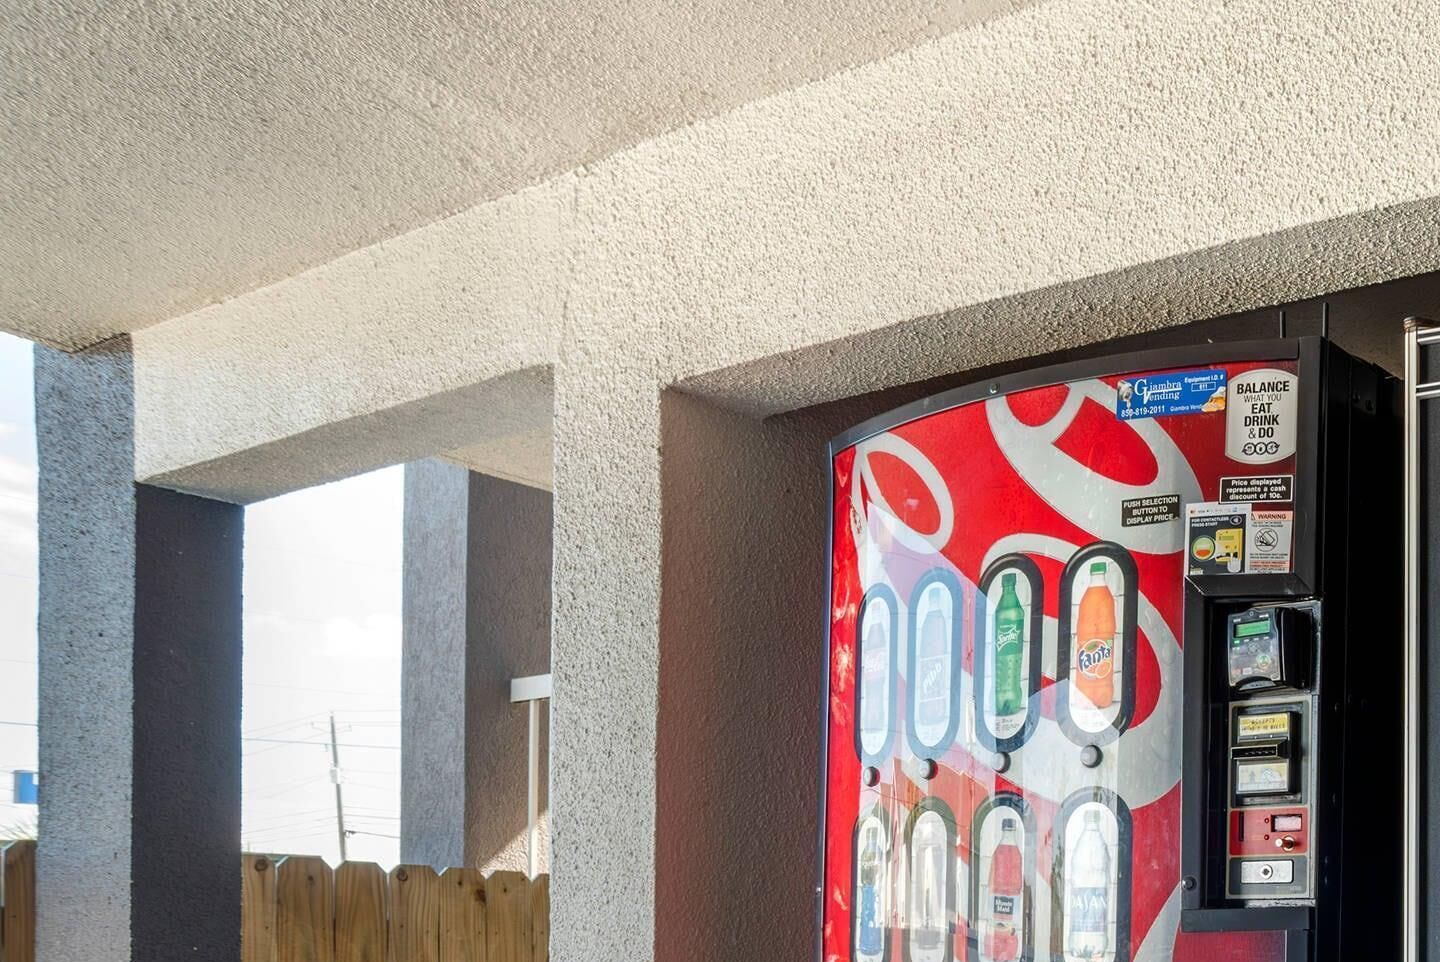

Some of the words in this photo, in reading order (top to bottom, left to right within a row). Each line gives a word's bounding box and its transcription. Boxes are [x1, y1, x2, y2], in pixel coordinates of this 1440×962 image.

[1134, 378, 1182, 396] Giambra
[1184, 376, 1210, 384] Equipment
[1237, 381, 1290, 395] BALANCE
[1143, 391, 1181, 404] Vending
[1244, 394, 1265, 403] WHAT
[1267, 393, 1282, 402] YOU
[1251, 402, 1272, 414] EAT
[1244, 414, 1279, 427] DRINK
[1248, 428, 1256, 439] &
[1258, 427, 1274, 438] DO
[1250, 479, 1282, 487] displayed
[1226, 486, 1261, 494] represents
[1124, 500, 1141, 508] PUSH
[1142, 496, 1178, 506] SELECTION
[1132, 507, 1159, 516] BUTTON
[1126, 516, 1153, 525] DISPLAY
[1153, 513, 1174, 522] PRICE
